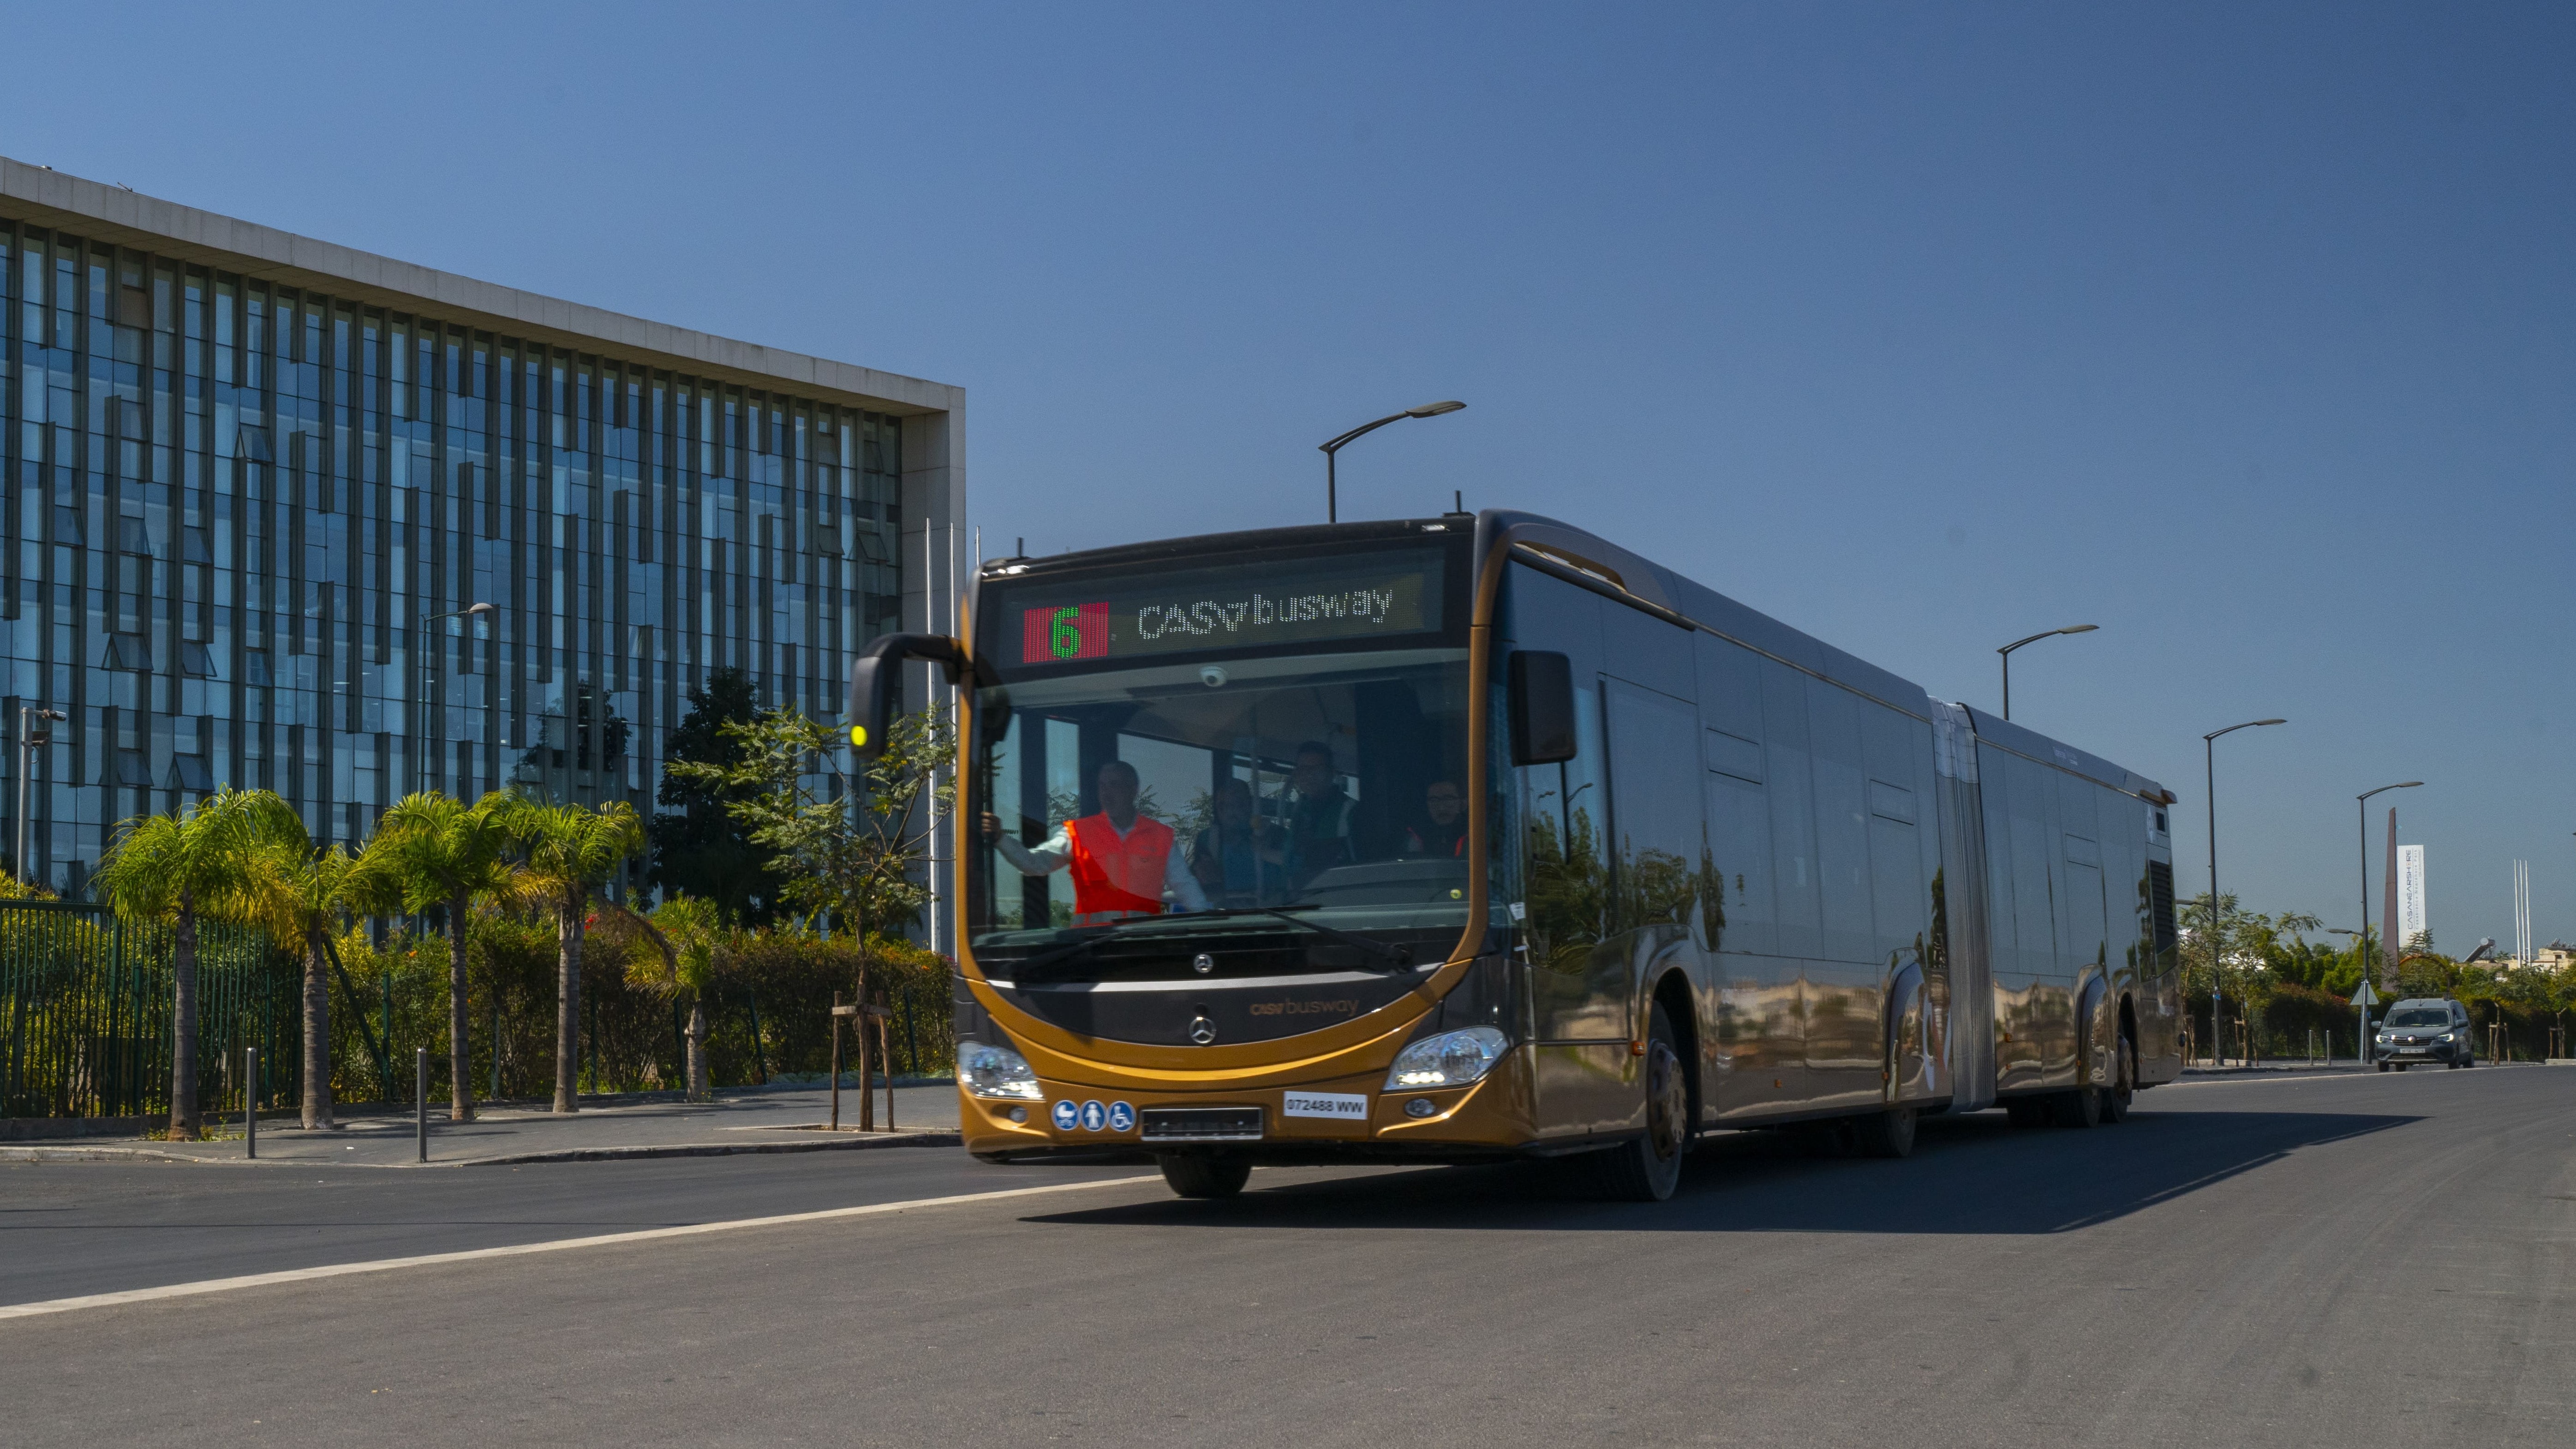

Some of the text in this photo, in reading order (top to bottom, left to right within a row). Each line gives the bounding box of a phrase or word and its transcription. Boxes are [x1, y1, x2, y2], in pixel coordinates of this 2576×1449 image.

[1053, 606, 1081, 659] 6
[1286, 1099, 1364, 1113] 072488 WW
